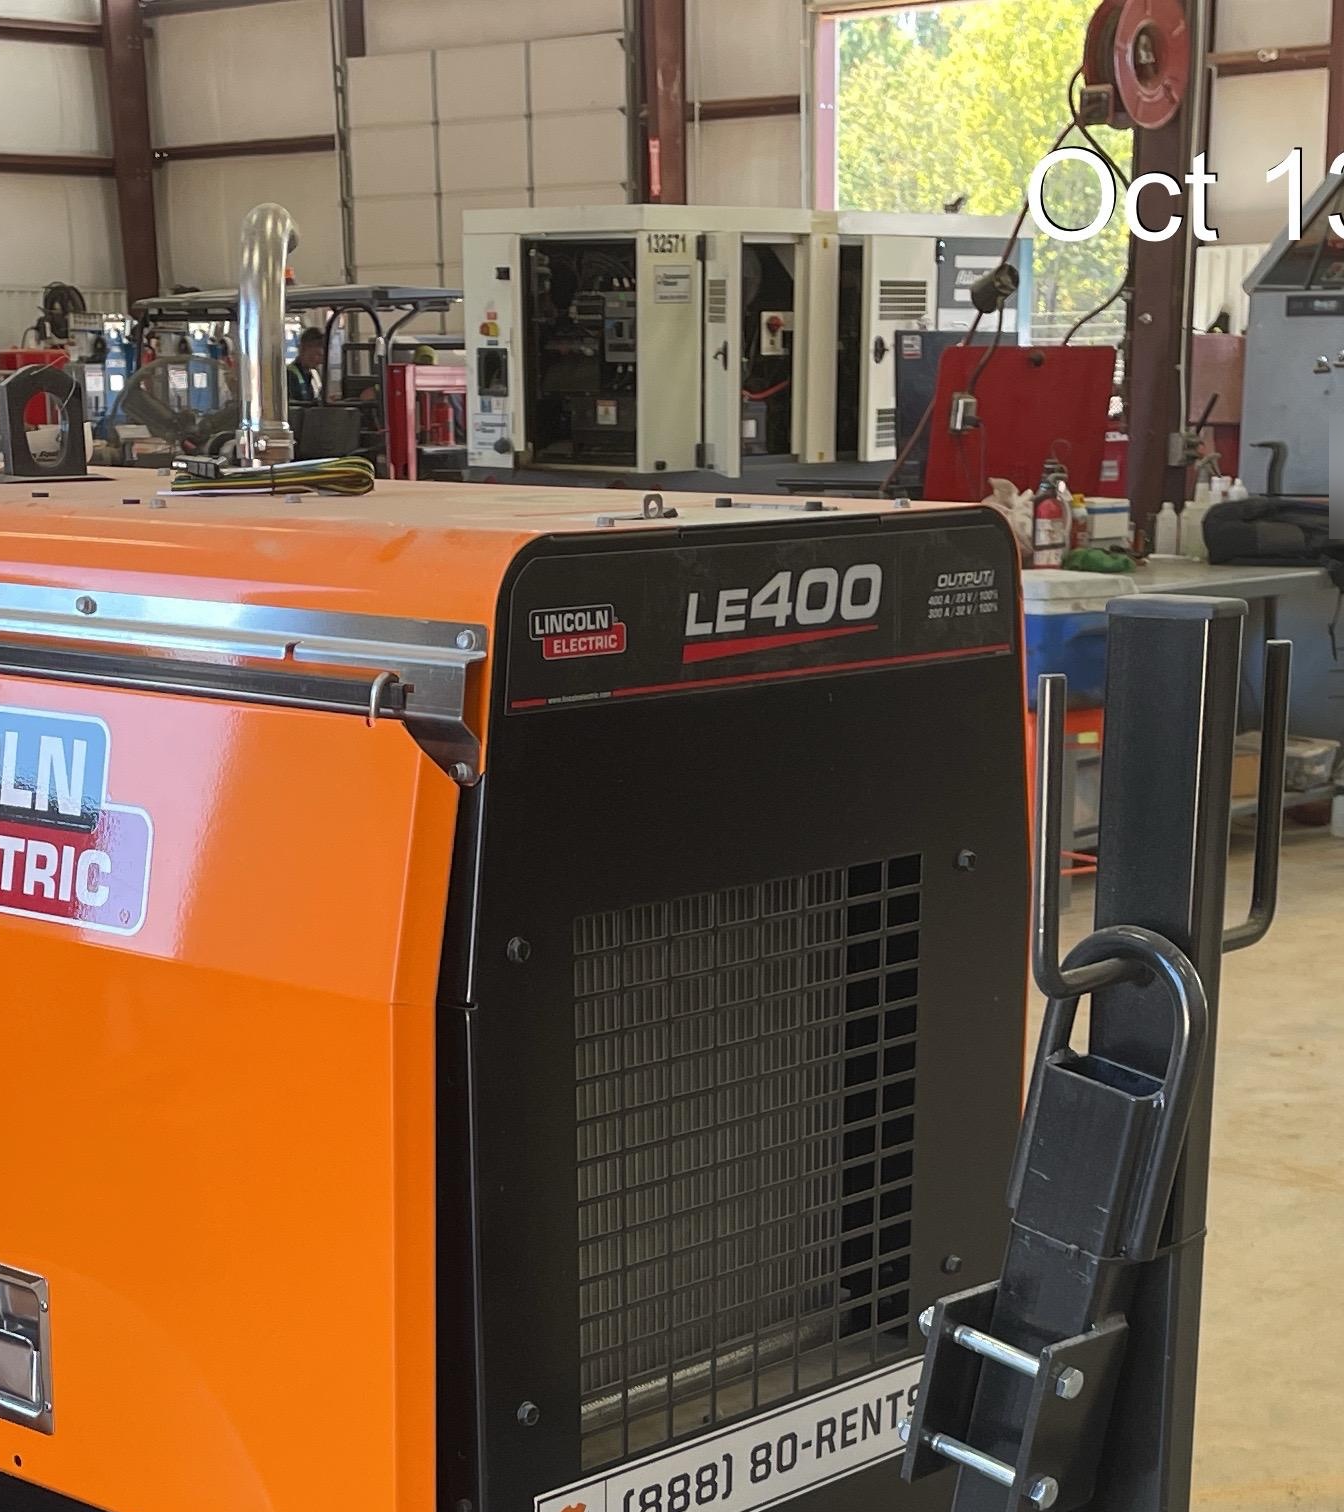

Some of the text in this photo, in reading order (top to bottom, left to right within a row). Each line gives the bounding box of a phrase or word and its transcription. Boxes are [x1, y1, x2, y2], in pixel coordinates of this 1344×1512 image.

[936, 569, 992, 588] OUTPUT
[684, 563, 883, 637] LE400
[534, 609, 610, 635] LINCOLN
[552, 634, 618, 654] ELECTRIC
